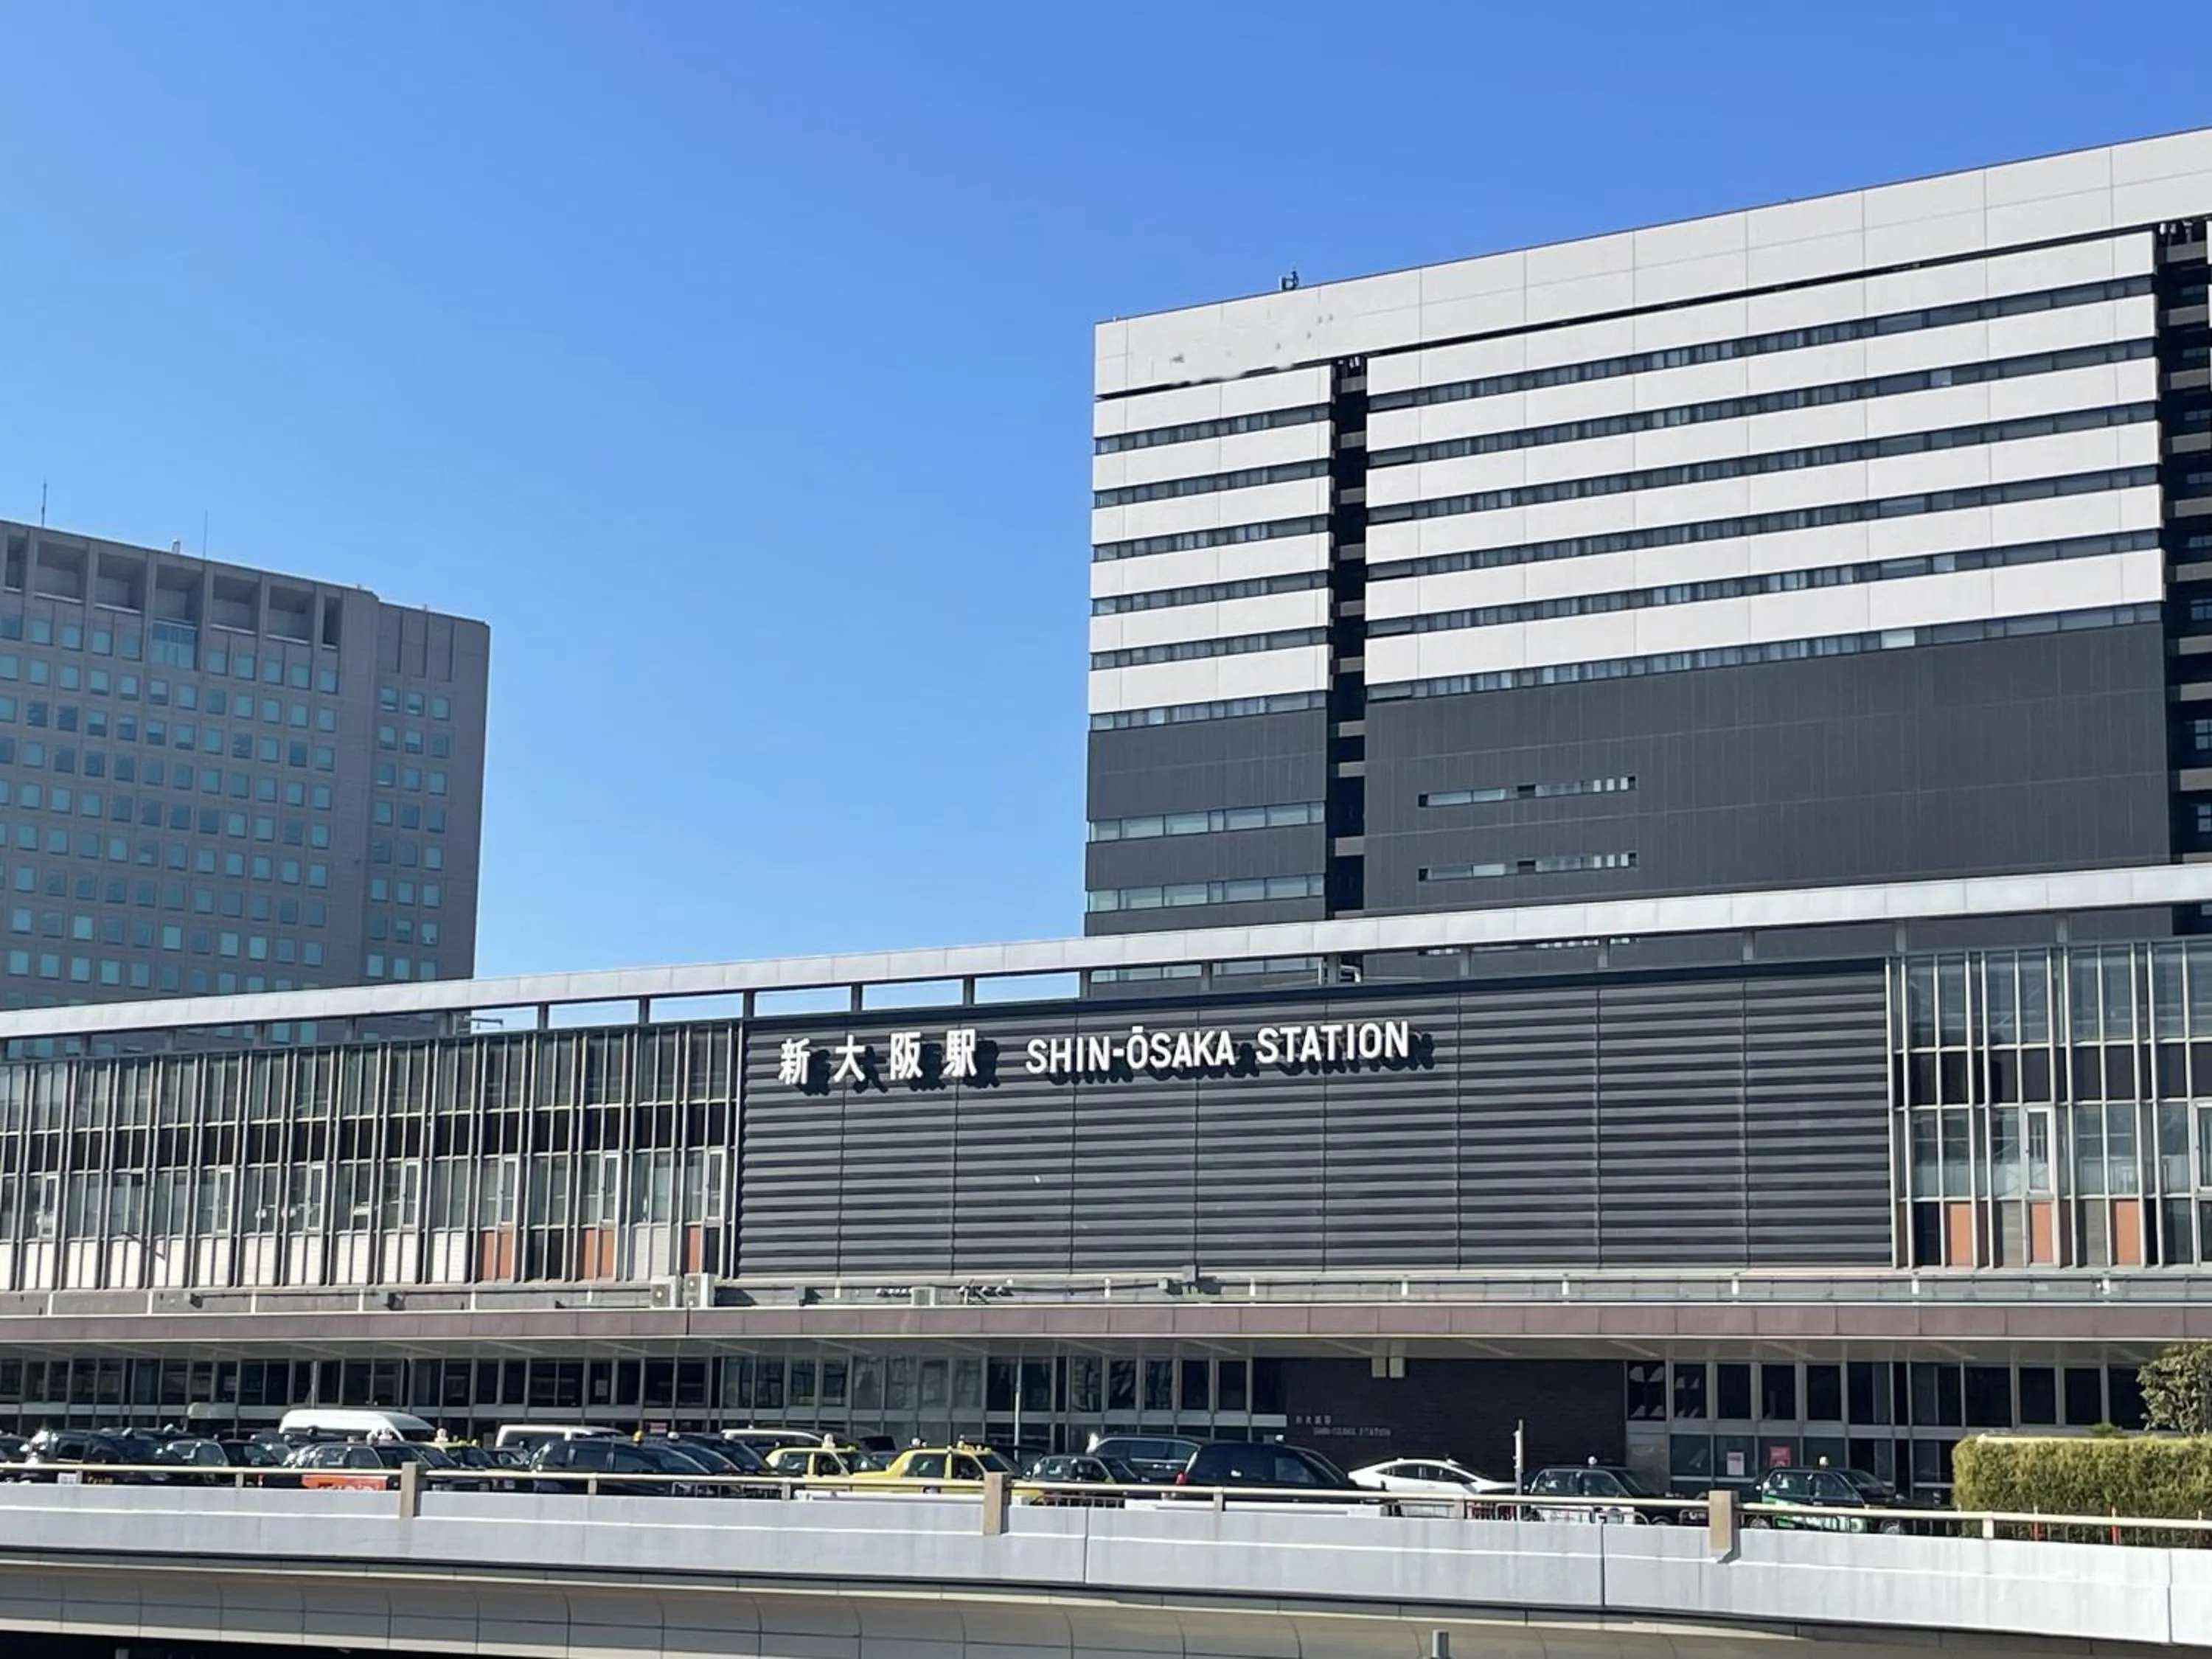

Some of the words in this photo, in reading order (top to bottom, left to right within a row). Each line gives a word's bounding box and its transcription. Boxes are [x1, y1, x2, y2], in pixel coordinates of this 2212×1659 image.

[778, 1029, 978, 1085] 新大阪駅
[1026, 1026, 1236, 1074] SHIN-ŌSAKA
[1256, 1020, 1409, 1064] STATION
